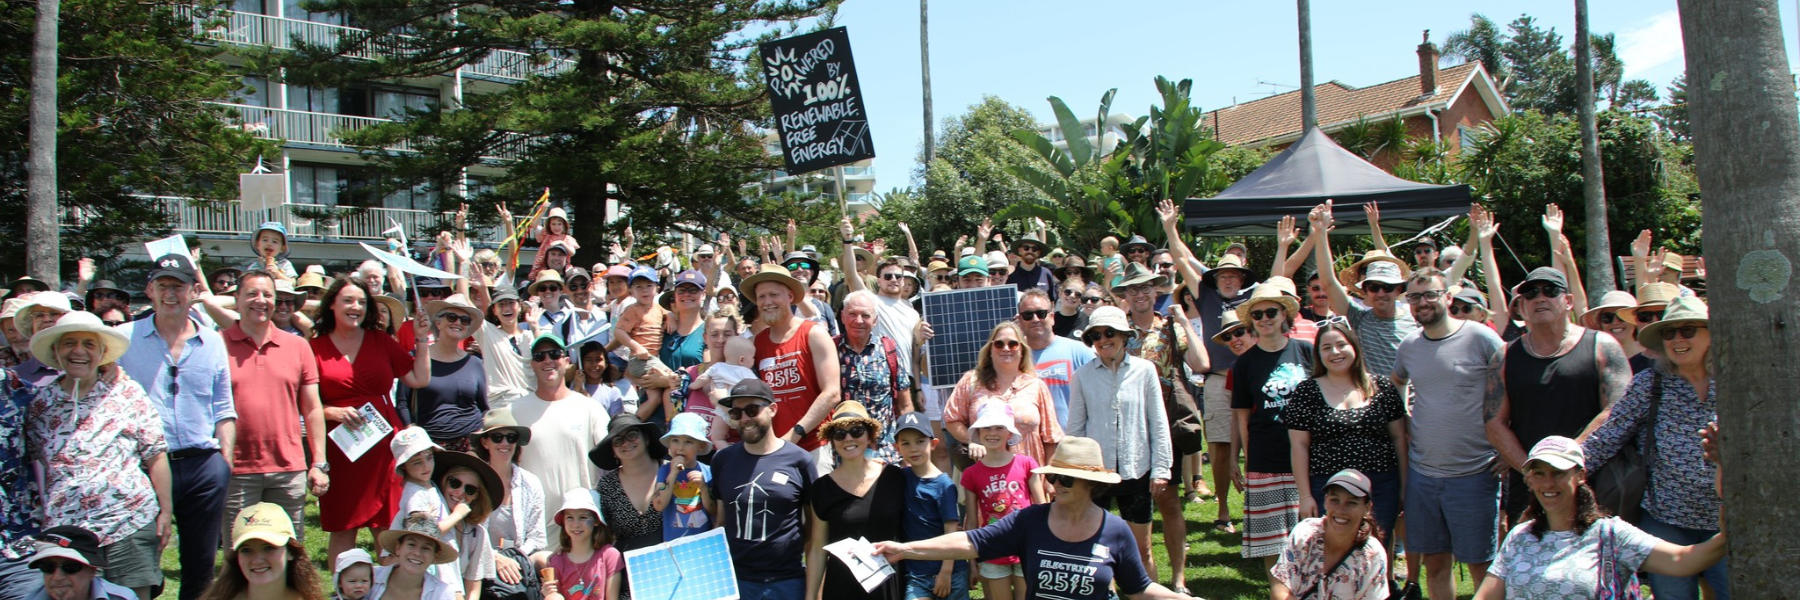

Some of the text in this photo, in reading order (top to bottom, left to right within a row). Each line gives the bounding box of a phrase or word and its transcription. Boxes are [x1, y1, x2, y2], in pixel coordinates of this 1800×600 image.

[770, 38, 835, 96] POWERED
[826, 61, 840, 78] BY
[802, 73, 851, 106] 100%
[786, 126, 817, 148] FREE
[791, 136, 845, 164] ENERGY
[1037, 367, 1066, 378] GUE
[1264, 398, 1291, 409] Austr
[982, 480, 1019, 497] HERO
[1040, 559, 1097, 576] ELECTRIFY
